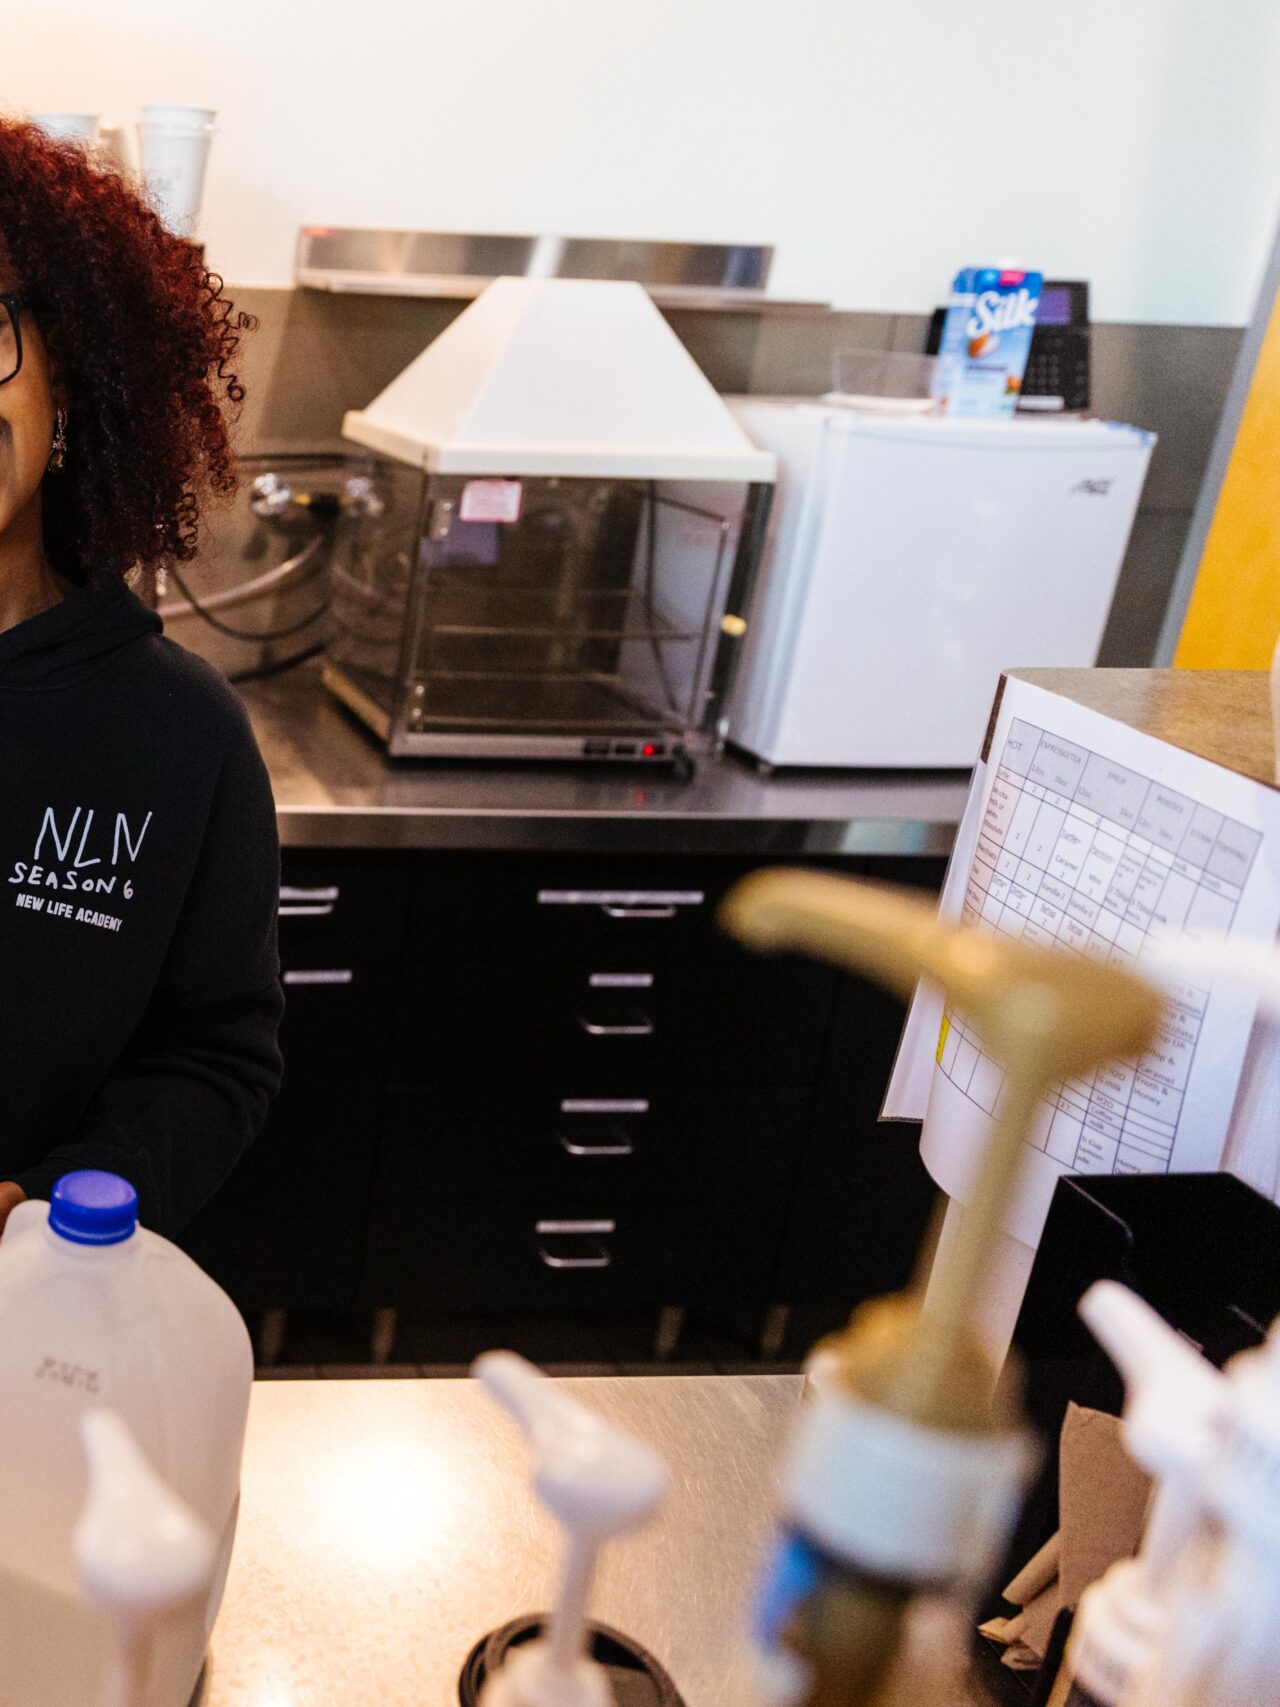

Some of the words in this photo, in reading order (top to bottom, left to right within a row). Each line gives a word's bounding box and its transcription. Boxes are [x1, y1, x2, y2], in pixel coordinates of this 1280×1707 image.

[967, 287, 1038, 337] Silk
[1007, 740, 1023, 752] HOT
[1040, 740, 1081, 763] ESPRESSO/TEA
[33, 806, 153, 868] NLN
[1055, 854, 1079, 872] Caramel
[8, 861, 117, 894] SEASON
[123, 879, 134, 899] 6
[15, 893, 45, 911] NEW
[46, 900, 74, 918] LIFE
[75, 907, 123, 932] ACADEMY
[1140, 1063, 1175, 1084] Caramel
[1096, 1095, 1114, 1109] H2O
[1134, 1088, 1161, 1106] Honey
[1091, 1104, 1113, 1122] Coffee
